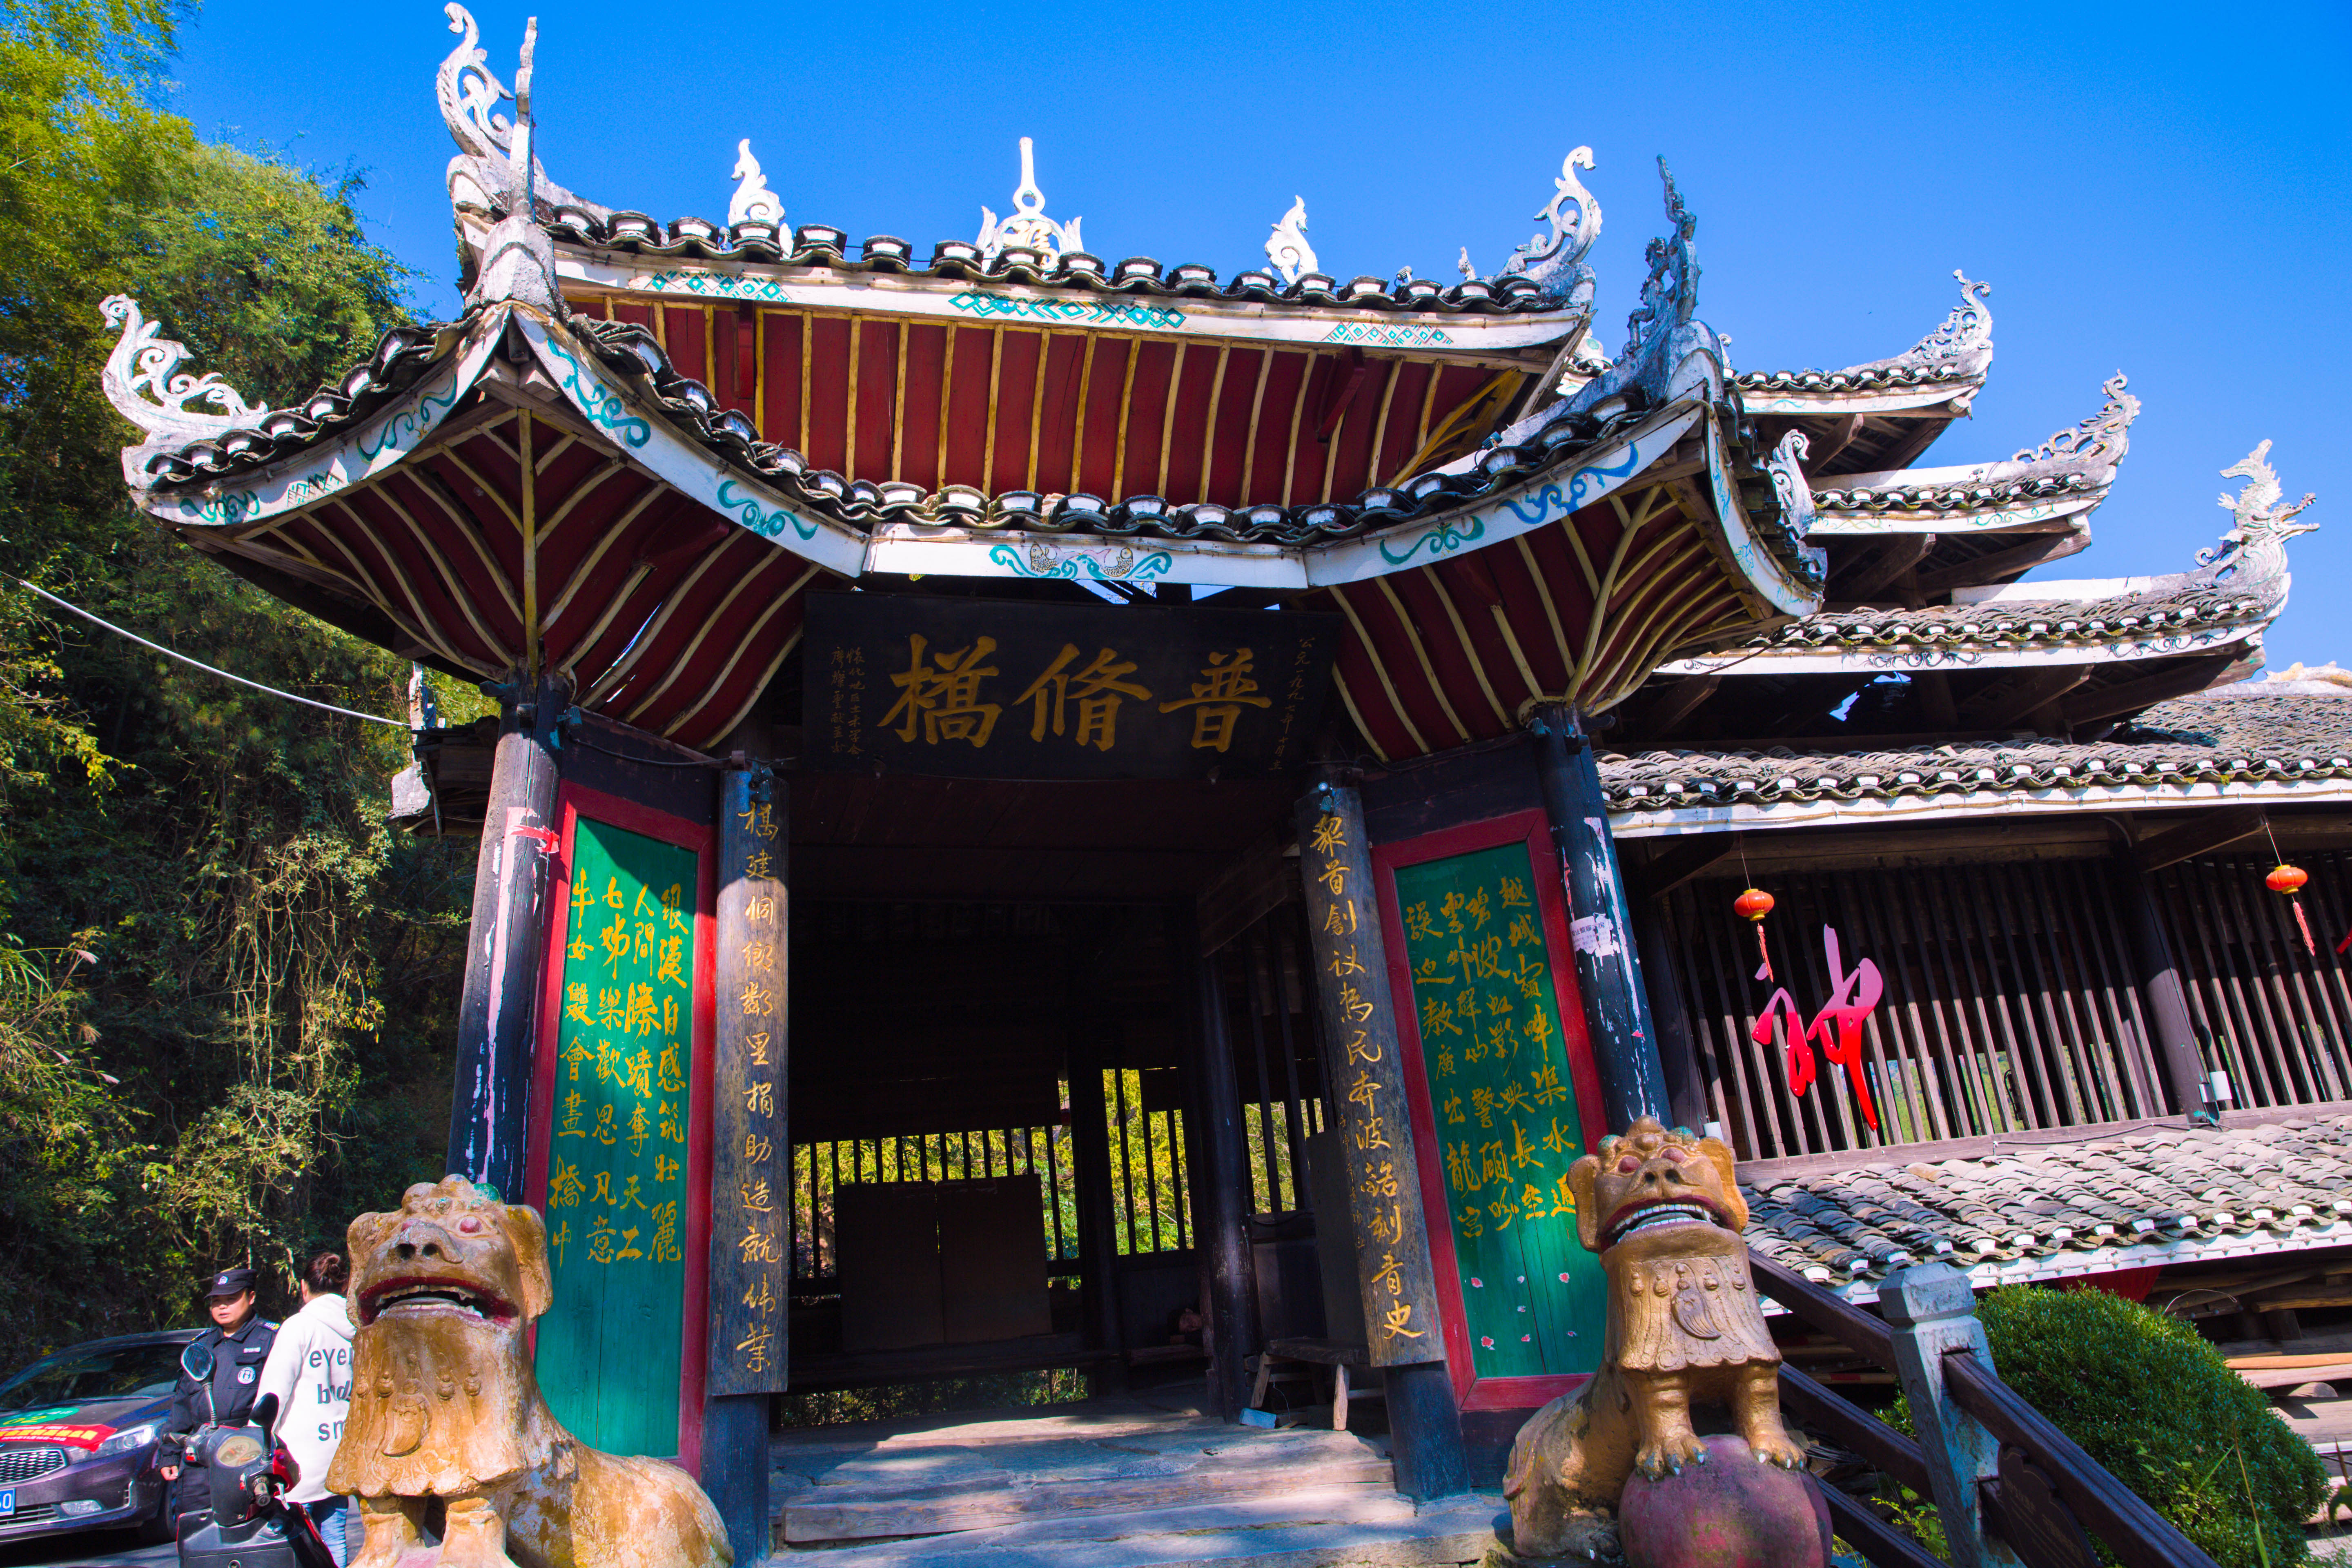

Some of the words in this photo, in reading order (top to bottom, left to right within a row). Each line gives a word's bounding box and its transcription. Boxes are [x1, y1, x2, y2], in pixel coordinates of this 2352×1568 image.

[317, 1380, 351, 1404] bd
[3, 1415, 47, 1425] 02
[0, 1493, 12, 1509] 0
